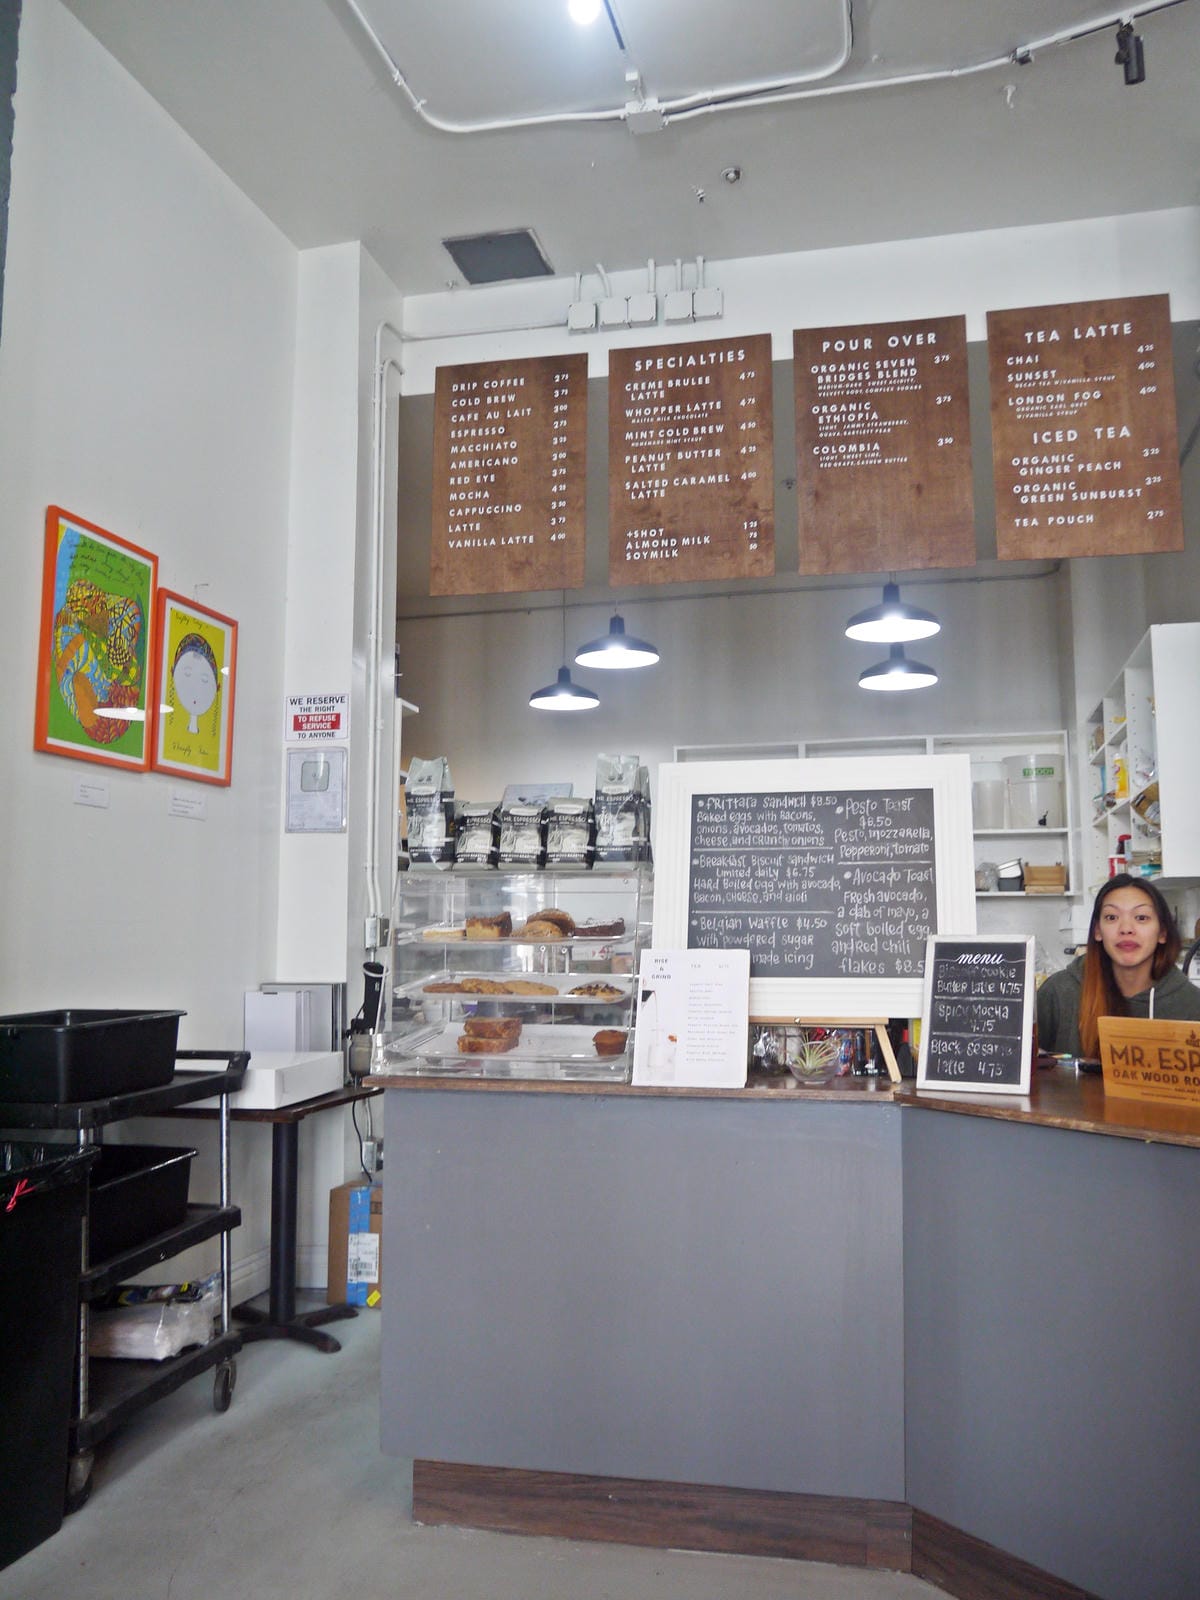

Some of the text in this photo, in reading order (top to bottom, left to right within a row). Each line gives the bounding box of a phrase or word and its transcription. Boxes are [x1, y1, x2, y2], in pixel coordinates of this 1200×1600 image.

[1025, 322, 1133, 344] TEA LATTE
[822, 332, 937, 353] POUR OVER
[635, 349, 746, 372] SPECIALTIES
[811, 362, 870, 374] ORGANIC
[876, 358, 915, 369] SEVEN
[1007, 355, 1039, 366] CHAI
[817, 368, 917, 384] BRIDGES BLEND
[1007, 369, 1057, 382] SUNSET
[452, 381, 478, 392] DRIP
[483, 378, 526, 389] COFFEE
[625, 380, 663, 392] CREME
[667, 376, 711, 387] BRULEE
[452, 397, 480, 408] COLD
[487, 394, 516, 405] BREW
[631, 391, 665, 401] LATTE
[1008, 393, 1065, 406] LONDON
[1074, 390, 1102, 401] FOG
[625, 405, 680, 418] WHOPPER
[687, 401, 721, 412] LATTE
[812, 402, 871, 414] ORGANIC
[451, 408, 532, 423] CAFE AU LAIT
[818, 411, 878, 424] ETHIOPIA
[451, 427, 505, 439] ESPRESSO
[625, 424, 724, 440] MINT COLD BREW
[1033, 426, 1131, 444] ICED TEA
[451, 441, 517, 454] MACCHIATO
[813, 442, 880, 455] COLOMBIA
[625, 449, 721, 464] PEANUT BUTTER
[1012, 453, 1075, 466] ORGANIC
[450, 457, 519, 470] AMERICANO
[631, 463, 666, 473] LATTE
[1019, 461, 1121, 476] GINGER PEACH
[450, 474, 496, 485] RED EYE
[625, 478, 668, 490] SALTED
[673, 474, 730, 487] CARAMEL
[631, 489, 666, 499] LATTE
[1013, 481, 1076, 494] ORGANIC
[449, 491, 490, 501] MOCHA
[1020, 488, 1143, 504] GREEN SUNBURST
[449, 504, 522, 517] CAPPUCCINO
[1015, 518, 1039, 527] TEA
[1048, 514, 1094, 525] POUCH
[449, 523, 481, 533] LATTE
[448, 538, 496, 549] VANILLA
[501, 535, 535, 545] LATTE
[626, 536, 711, 550] ALMOND MILK
[626, 550, 678, 560] SOYMILK
[289, 696, 346, 706] WE RESERVE
[309, 714, 337, 722] REFUSE
[302, 722, 332, 730] SERVICE
[837, 906, 845, 918] a
[873, 905, 886, 919] of
[922, 908, 929, 920] a
[956, 952, 1005, 965] menu
[1109, 1044, 1151, 1068] MR.
[1113, 1069, 1138, 1080] OAK
[1142, 1071, 1179, 1084] WOOD
